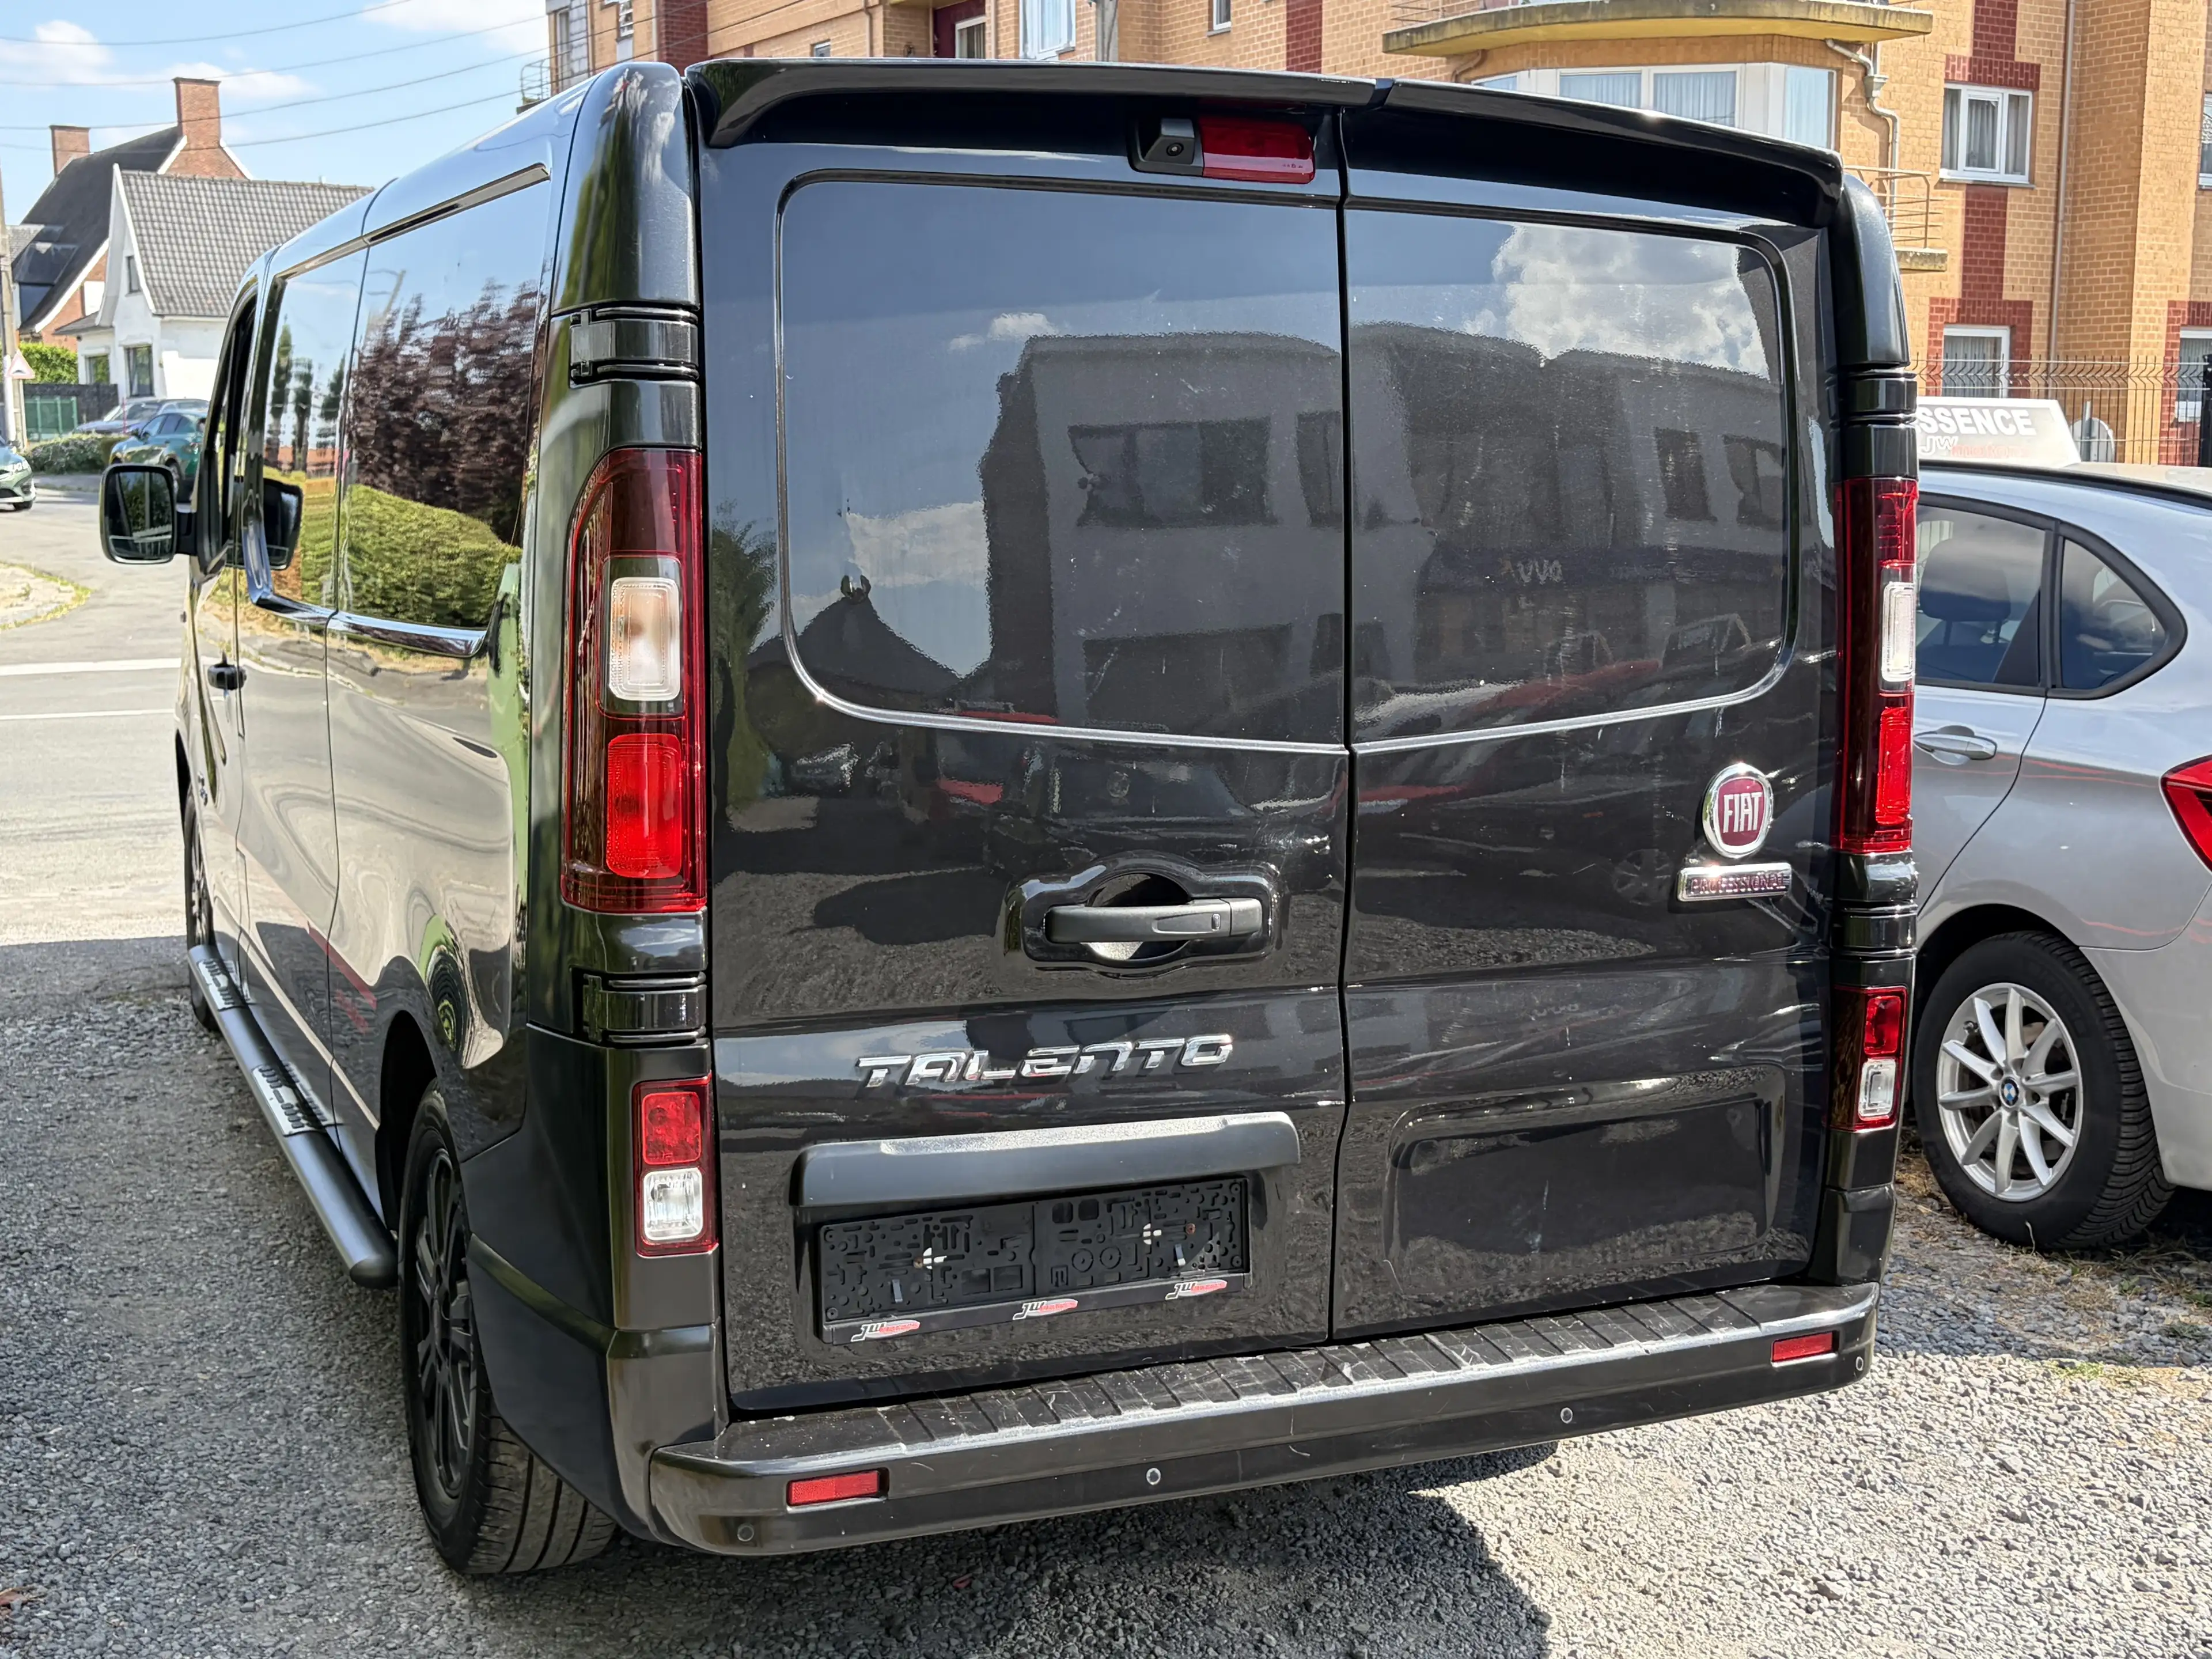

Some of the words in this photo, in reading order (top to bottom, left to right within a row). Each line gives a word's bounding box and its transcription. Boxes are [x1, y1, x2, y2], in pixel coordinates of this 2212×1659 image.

[1917, 406, 2037, 436] SSENCE
[1722, 791, 1763, 834] FIAT
[857, 1034, 1234, 1088] TALENTO
